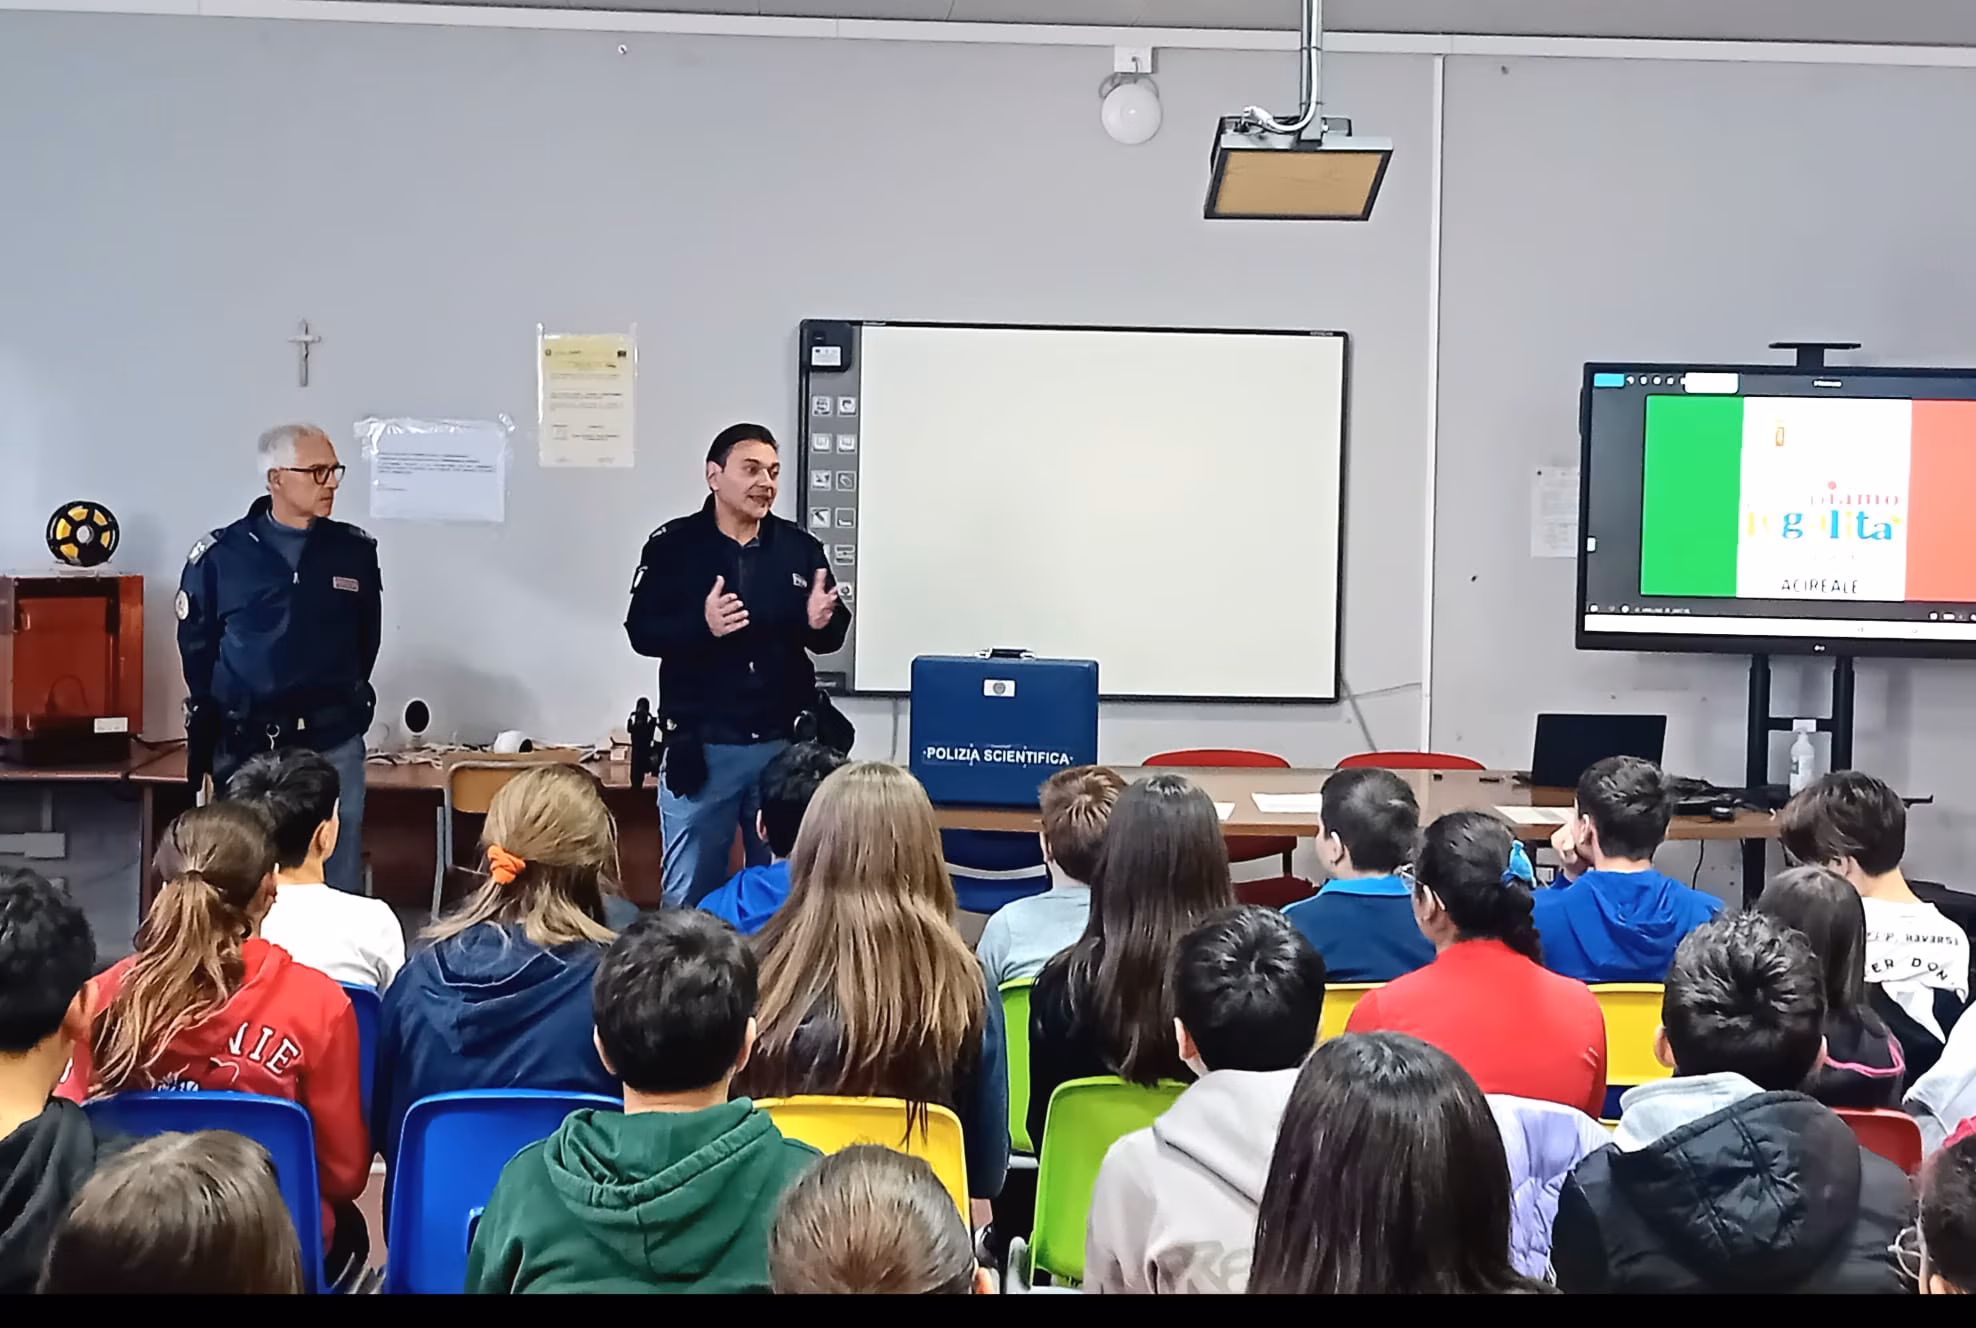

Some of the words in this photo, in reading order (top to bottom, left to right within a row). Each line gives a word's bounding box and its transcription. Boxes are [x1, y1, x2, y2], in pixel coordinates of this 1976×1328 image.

[1781, 578, 1859, 594] ACIREALE
[926, 746, 981, 762] POLIZIA
[983, 749, 1071, 766] SCIENTIFICA
